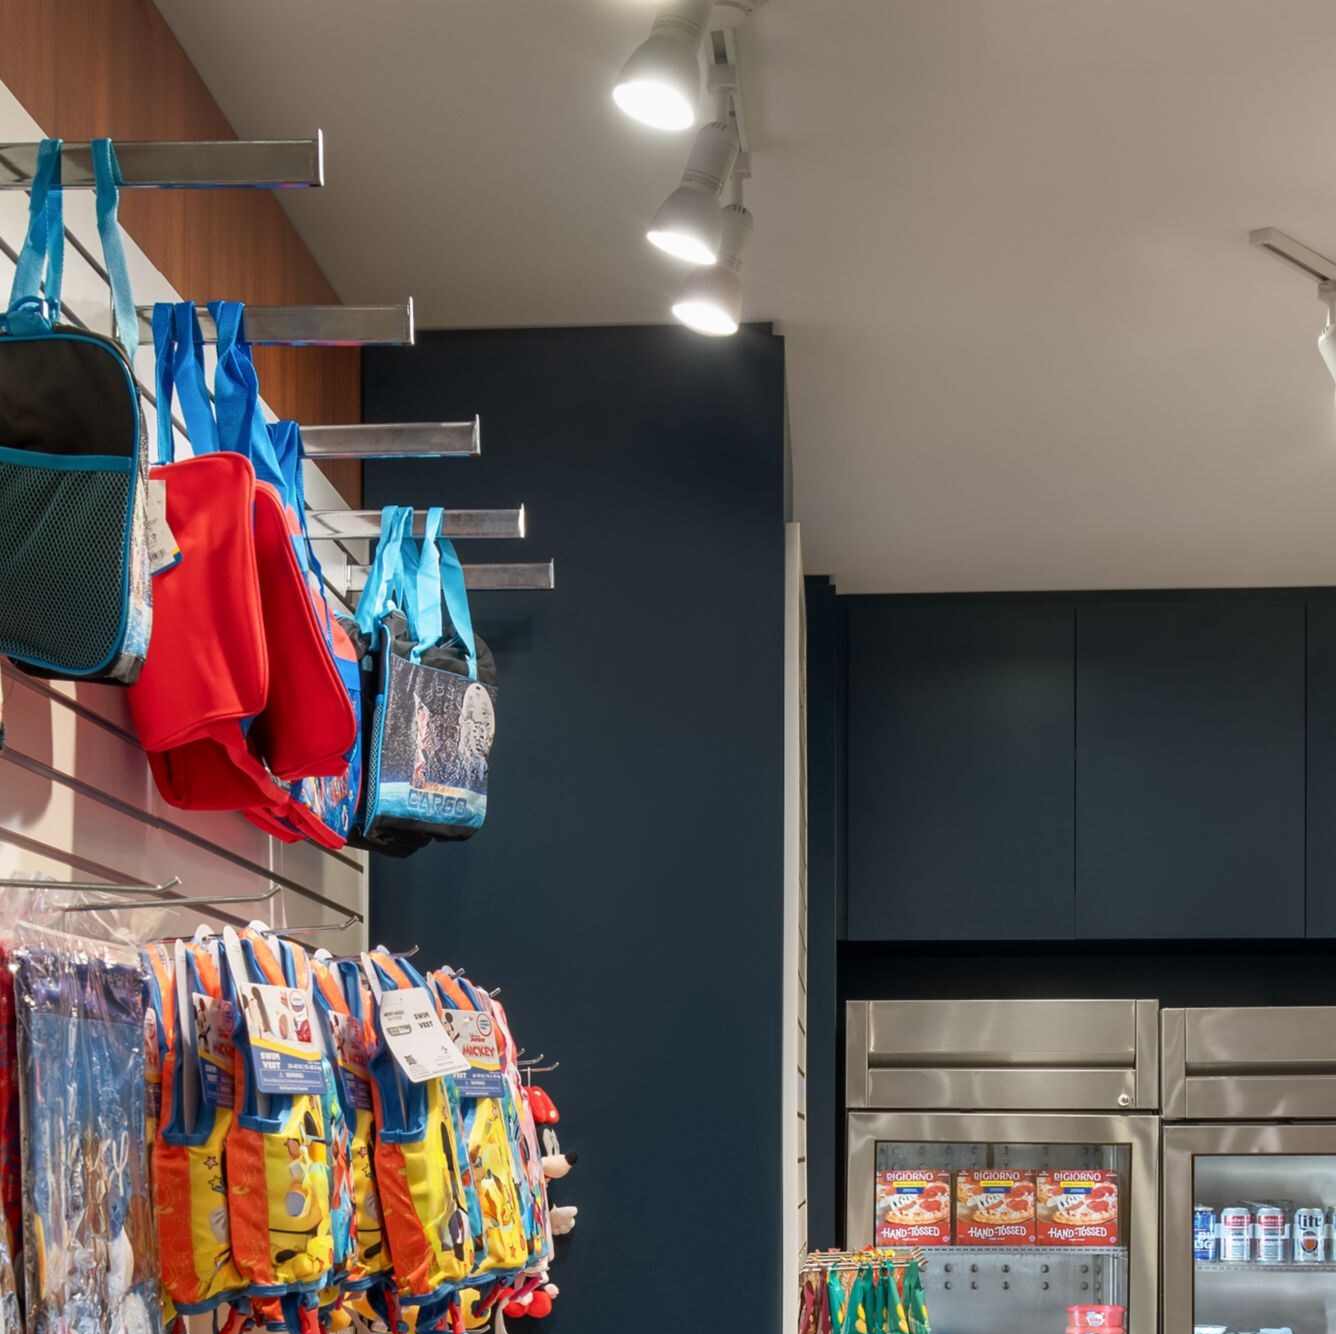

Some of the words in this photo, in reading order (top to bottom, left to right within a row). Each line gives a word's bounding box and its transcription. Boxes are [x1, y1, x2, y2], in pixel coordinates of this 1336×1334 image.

[408, 788, 467, 817] CARGO
[413, 1011, 430, 1020] SWIM
[418, 1020, 434, 1029] VEST
[462, 1045, 495, 1057] MICKEY
[262, 1061, 281, 1070] VEST
